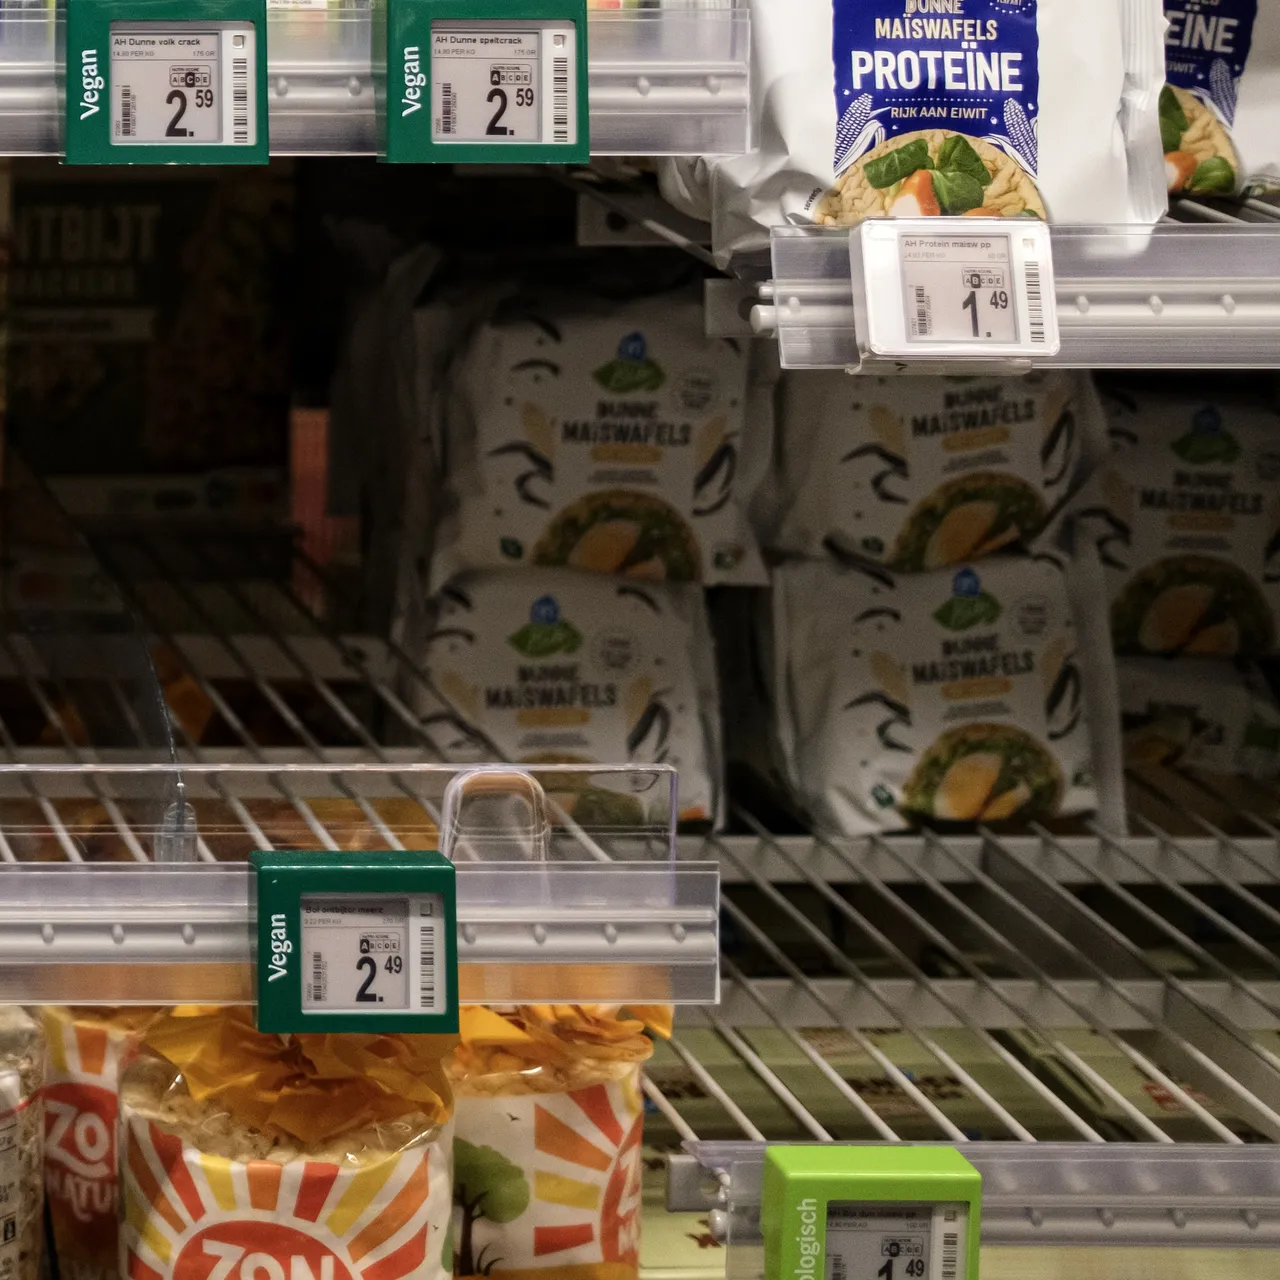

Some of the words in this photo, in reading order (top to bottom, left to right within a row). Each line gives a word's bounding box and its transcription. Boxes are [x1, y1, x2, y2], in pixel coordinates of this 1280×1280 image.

[875, 13, 998, 41] MAÏSWAFELS
[479, 37, 522, 45] speltcrack
[851, 42, 1023, 91] PROTEÏNE
[80, 49, 105, 120] Vegan
[515, 88, 534, 107] 59
[891, 107, 917, 118] RIJK
[920, 107, 947, 118] AAN
[950, 108, 988, 119] EIWIT
[919, 240, 949, 248] Protein
[990, 290, 1008, 310] 49
